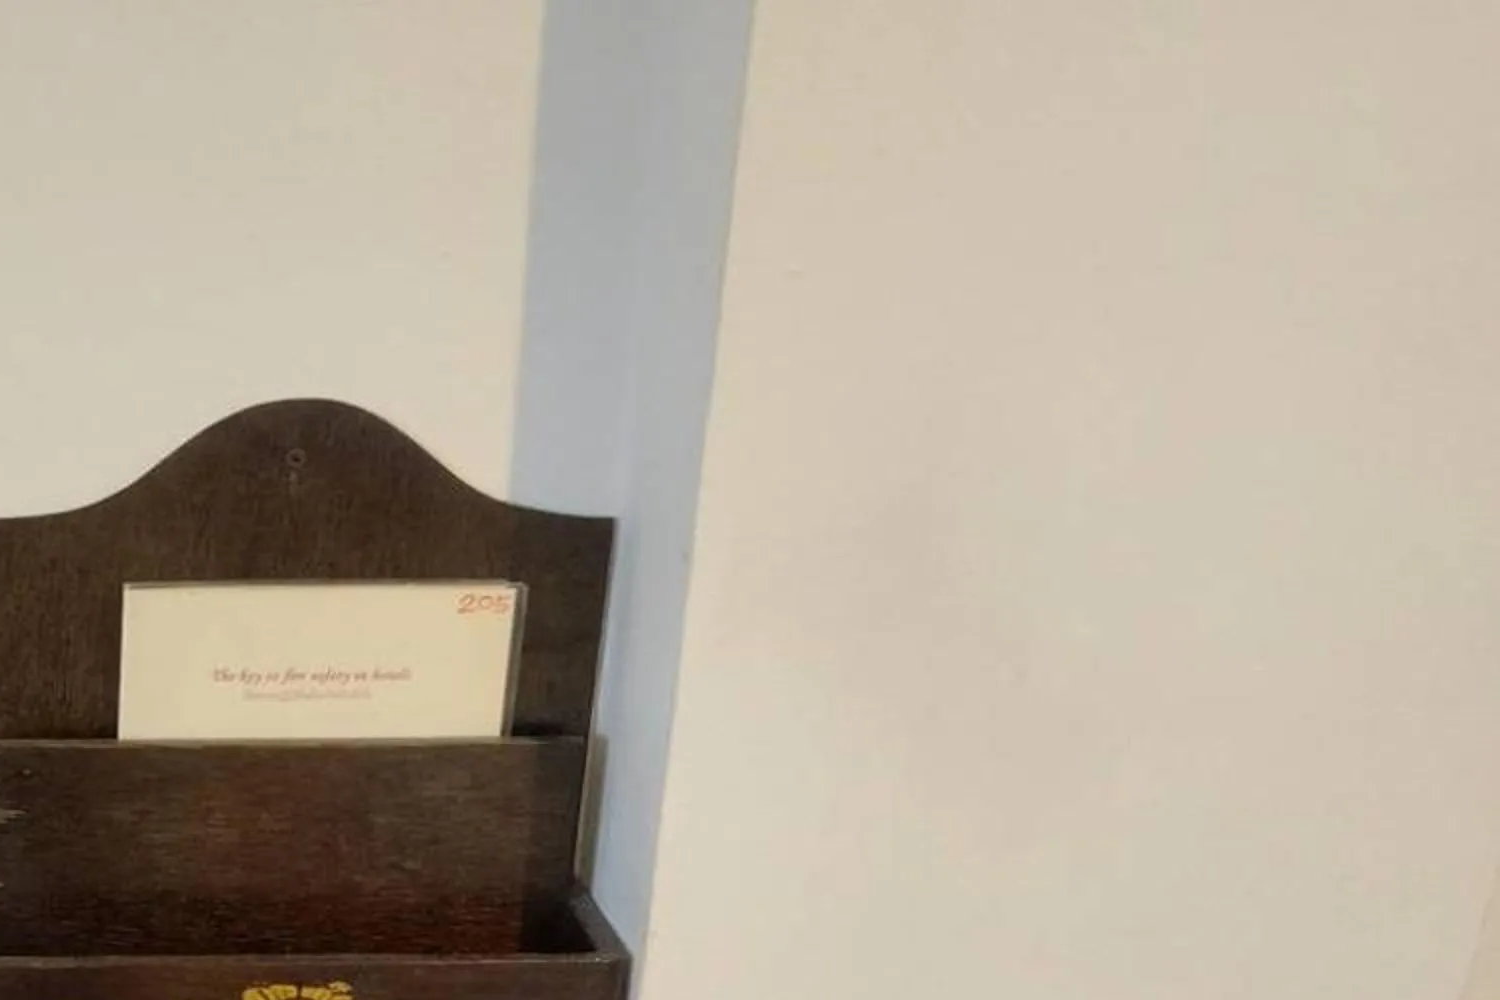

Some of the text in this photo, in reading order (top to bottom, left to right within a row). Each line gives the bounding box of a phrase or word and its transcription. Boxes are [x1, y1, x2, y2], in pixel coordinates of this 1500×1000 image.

[456, 593, 511, 615] 205
[213, 667, 236, 683] The
[239, 668, 262, 687] key
[310, 667, 351, 686] safety
